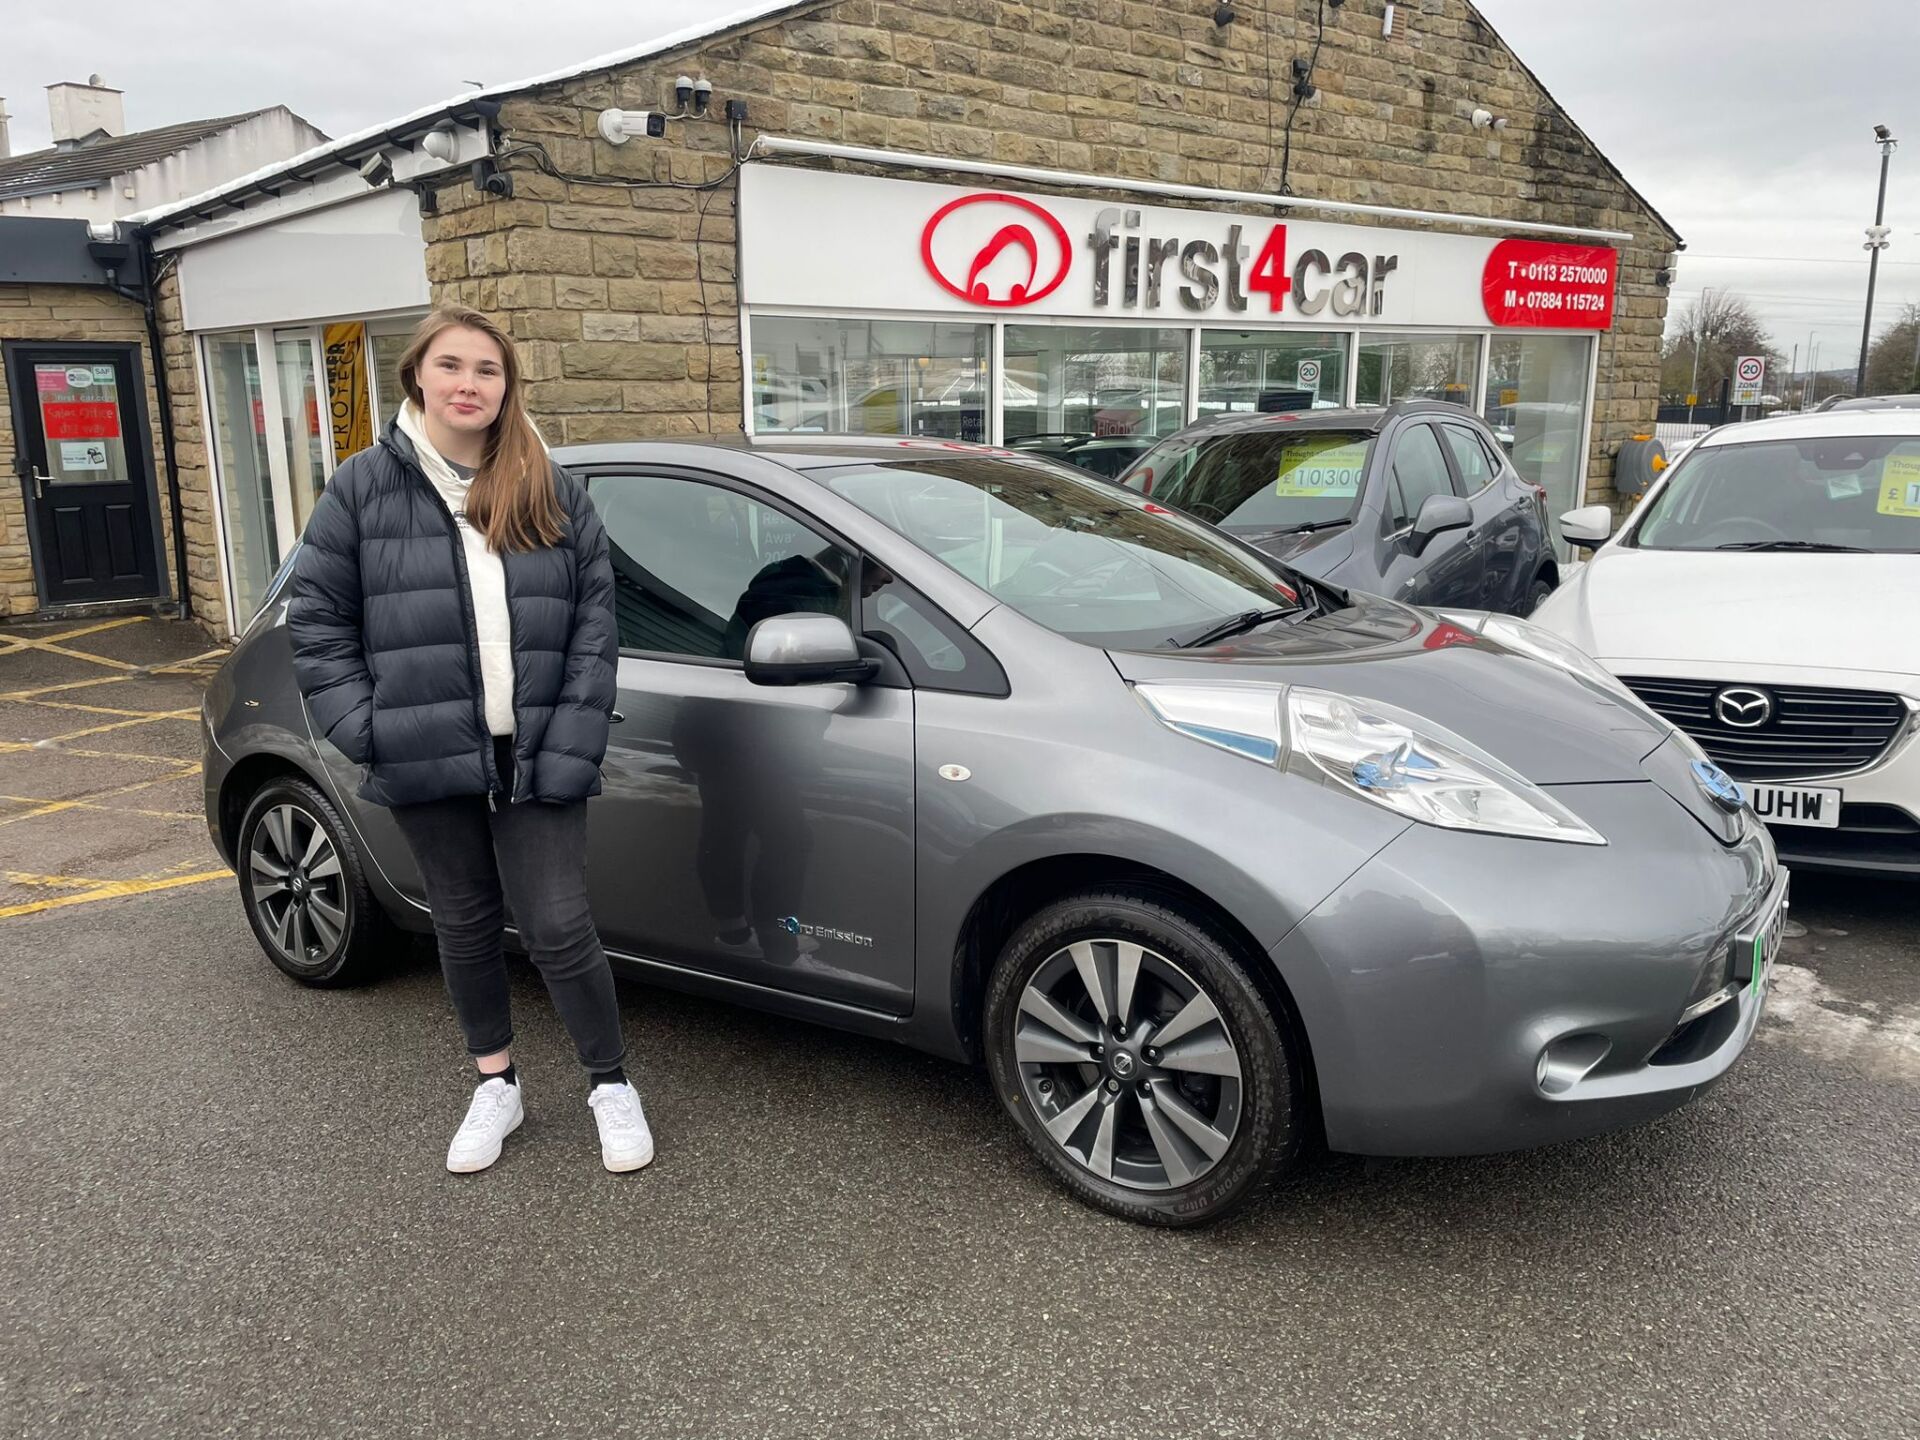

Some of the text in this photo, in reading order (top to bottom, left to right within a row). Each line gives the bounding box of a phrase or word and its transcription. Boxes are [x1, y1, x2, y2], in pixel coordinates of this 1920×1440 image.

[1088, 207, 1398, 317] first4car
[1559, 265, 1608, 284] 2570000
[1565, 293, 1604, 310] 115724
[1302, 367, 1316, 377] 20
[1742, 364, 1759, 375] 20
[1753, 787, 1822, 820] UHW
